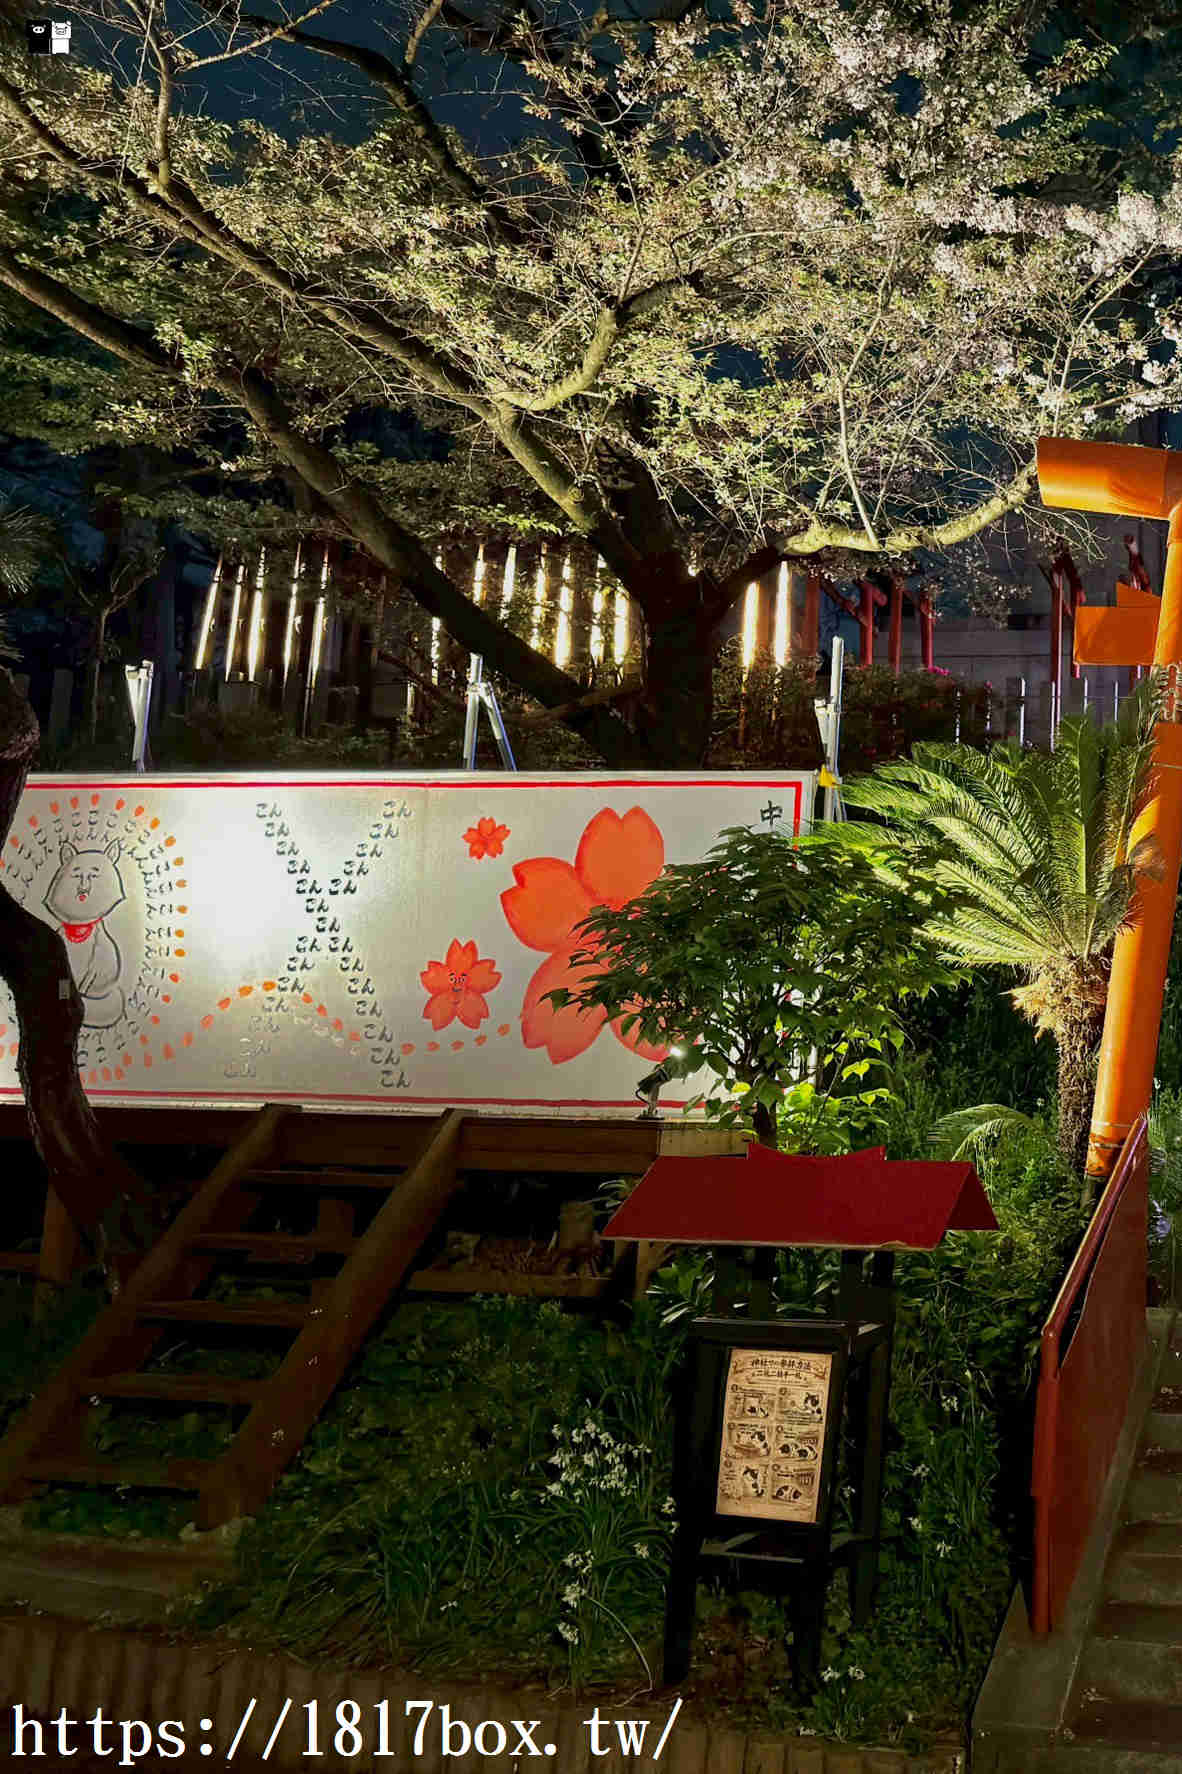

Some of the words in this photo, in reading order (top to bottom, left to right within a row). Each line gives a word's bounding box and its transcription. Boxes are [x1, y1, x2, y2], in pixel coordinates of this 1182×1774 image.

[255, 803, 282, 818] こん
[382, 801, 412, 819] こん
[760, 799, 783, 827] 中
[264, 822, 290, 838] こん
[369, 823, 399, 839] こん
[275, 841, 300, 857] こん
[355, 843, 383, 858] こん
[287, 859, 311, 875] こん
[343, 861, 369, 876] こん
[295, 879, 322, 895] こん
[328, 878, 357, 896] こん
[305, 898, 329, 914] こん
[315, 917, 341, 933] こん
[295, 936, 321, 953] こん
[328, 936, 353, 953] こん
[287, 956, 315, 972] こん
[339, 957, 365, 973] こん
[277, 977, 305, 993] こん
[347, 978, 375, 995] こん
[355, 1000, 382, 1018] こん
[363, 1024, 393, 1043] こん
[370, 1048, 400, 1066] こん
[379, 1070, 411, 1088] こん
